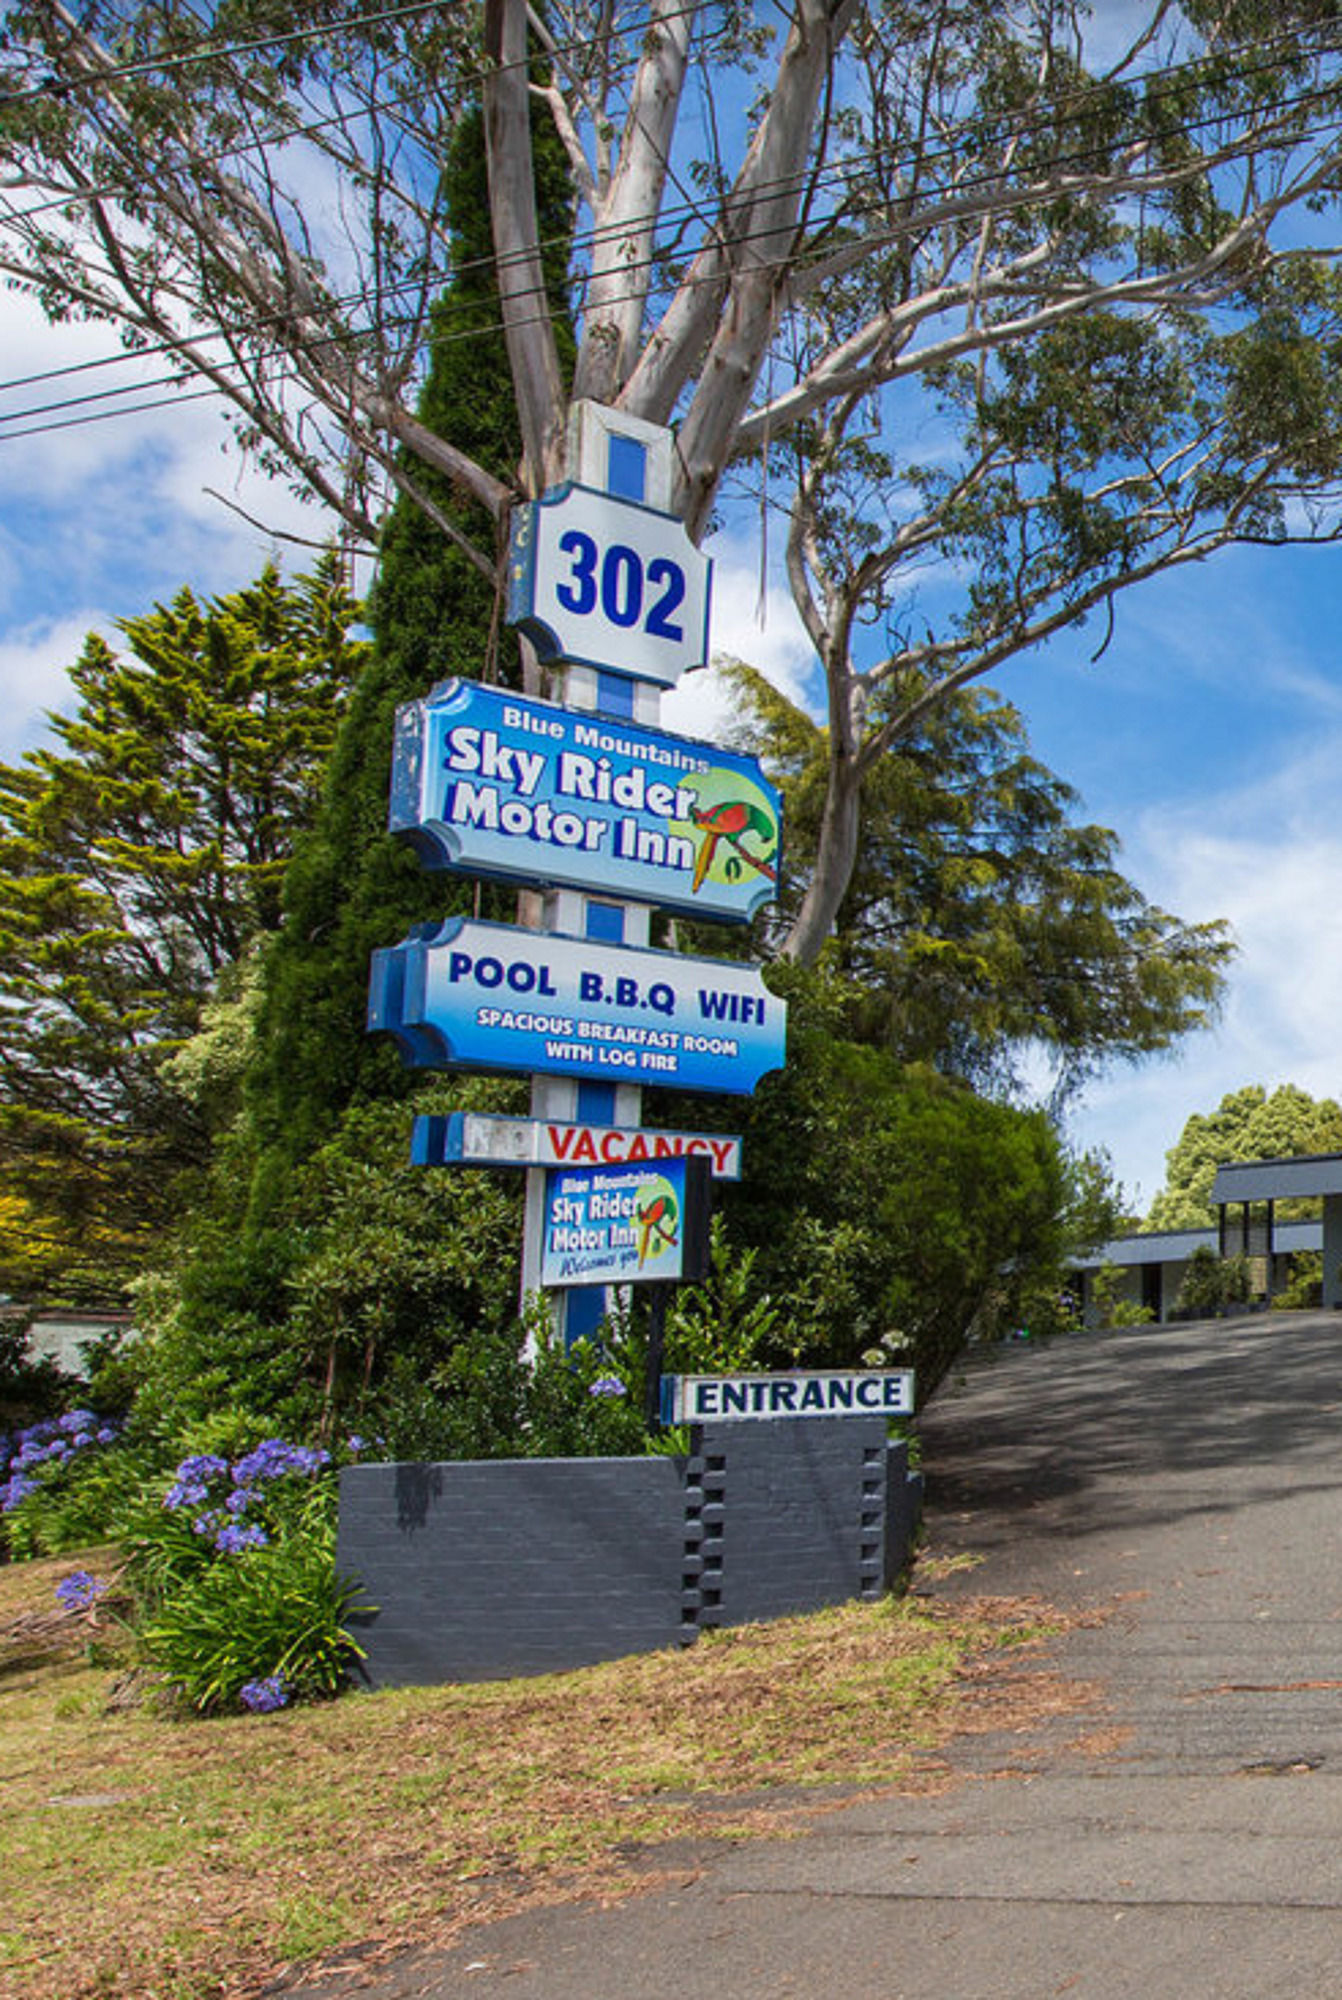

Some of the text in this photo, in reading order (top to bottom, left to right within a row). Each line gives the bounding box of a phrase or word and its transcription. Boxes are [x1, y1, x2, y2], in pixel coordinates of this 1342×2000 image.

[556, 529, 686, 642] 302
[503, 706, 710, 774] Blue Mountains
[447, 727, 699, 820] Sky Rider
[446, 782, 695, 870] Motor Inn
[449, 951, 766, 1026] POOL B.B.Q WIFI
[477, 1008, 738, 1057] SPACIOUS BREAKFAST ROOM
[545, 1041, 678, 1072] WITH LOG FIRE
[551, 1192, 640, 1227] Sky Rider
[562, 1178, 589, 1193] Blue
[550, 1223, 639, 1252] Motor Inn
[695, 1377, 901, 1414] ENTRANCE
